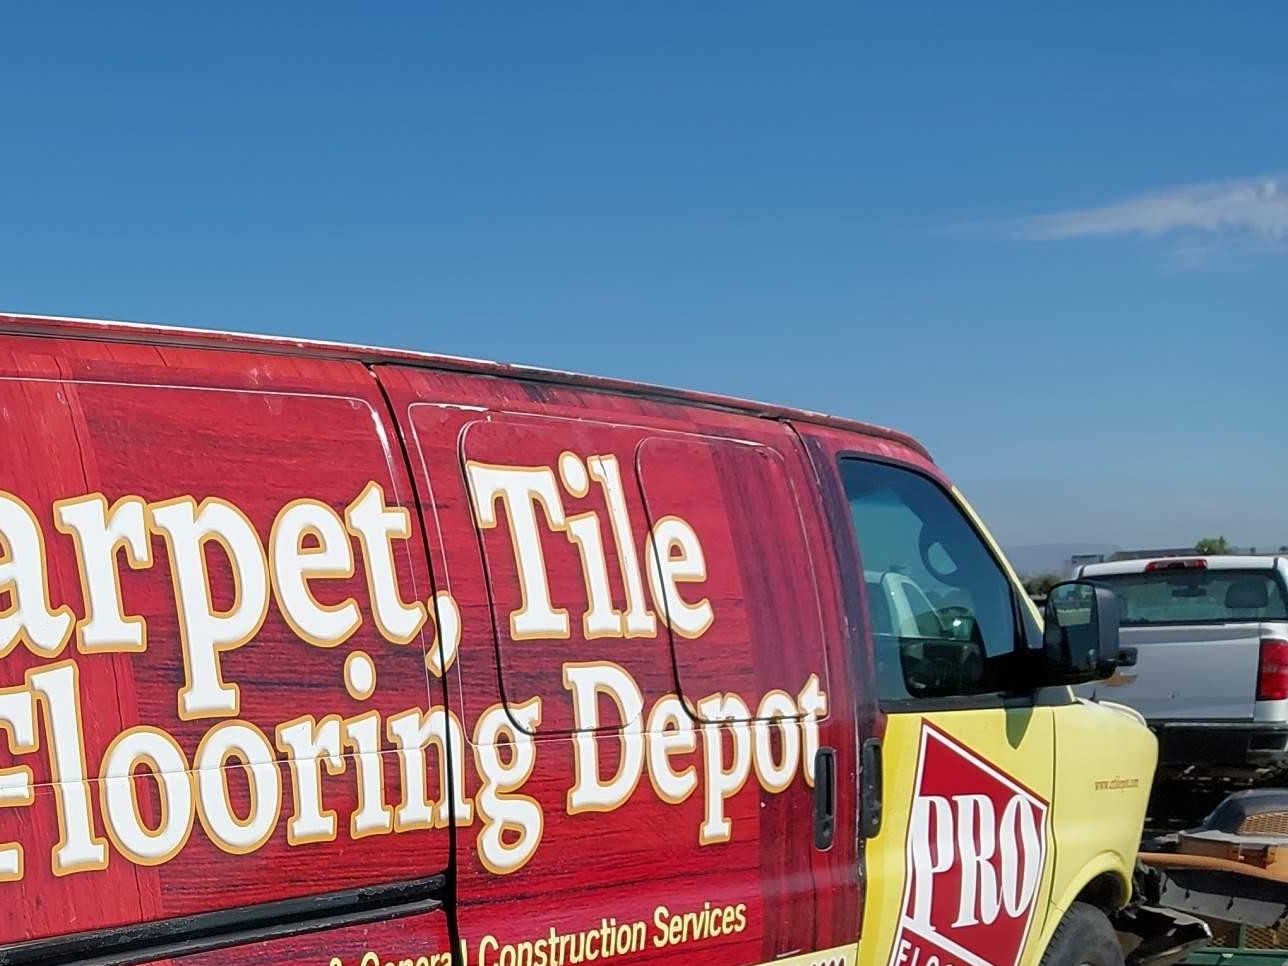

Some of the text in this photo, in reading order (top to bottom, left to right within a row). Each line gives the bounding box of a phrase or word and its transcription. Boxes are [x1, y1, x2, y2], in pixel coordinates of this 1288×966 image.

[467, 451, 713, 640] Tile
[563, 662, 827, 844] Depot
[653, 903, 747, 948] Services
[905, 794, 1041, 931] PRO
